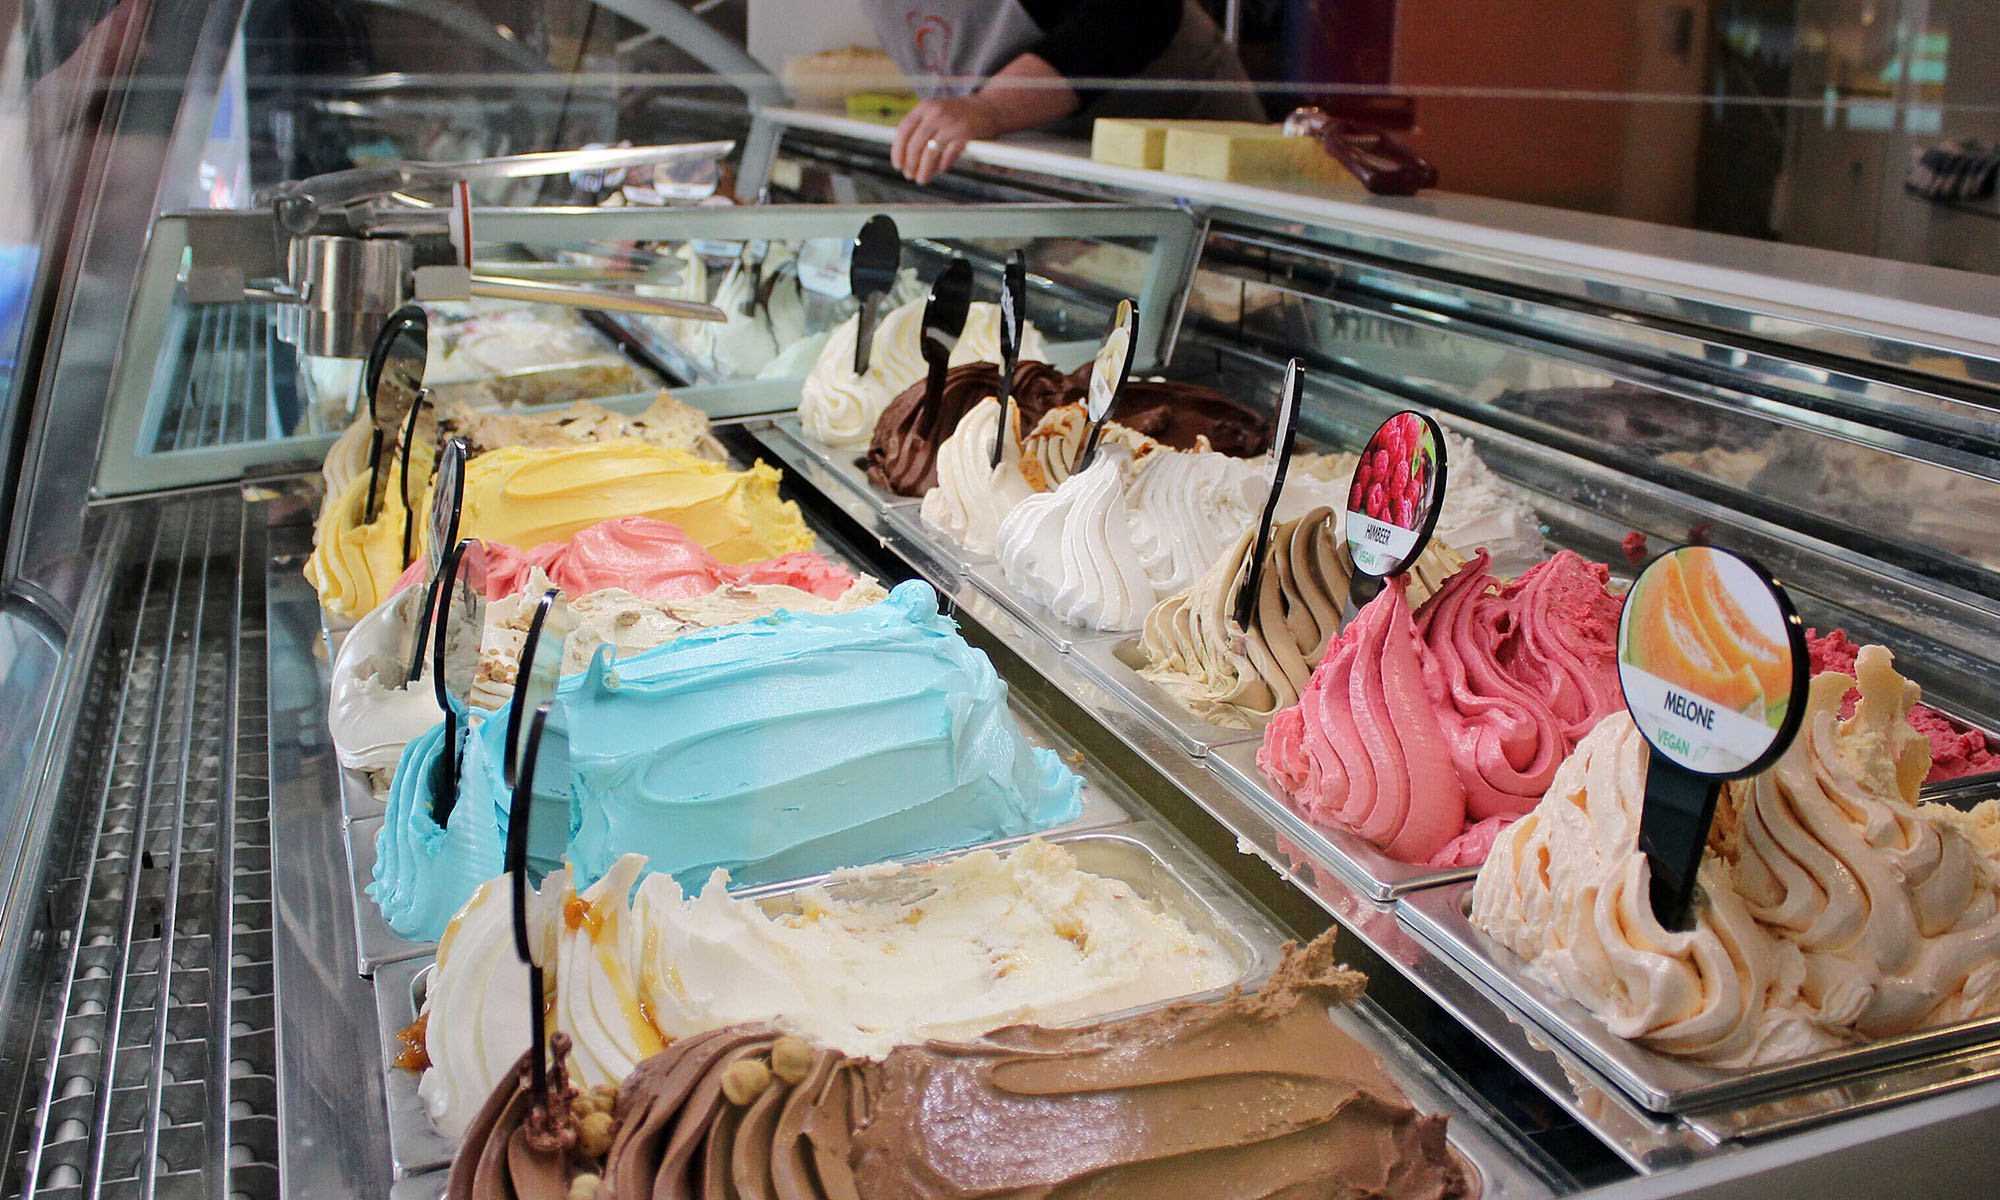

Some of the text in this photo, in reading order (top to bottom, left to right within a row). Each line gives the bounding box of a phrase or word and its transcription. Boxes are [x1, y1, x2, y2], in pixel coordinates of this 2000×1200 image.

[1365, 523, 1391, 545] HIMBEER
[1664, 690, 1715, 731] MELONE
[1658, 728, 1690, 756] VEGAN
